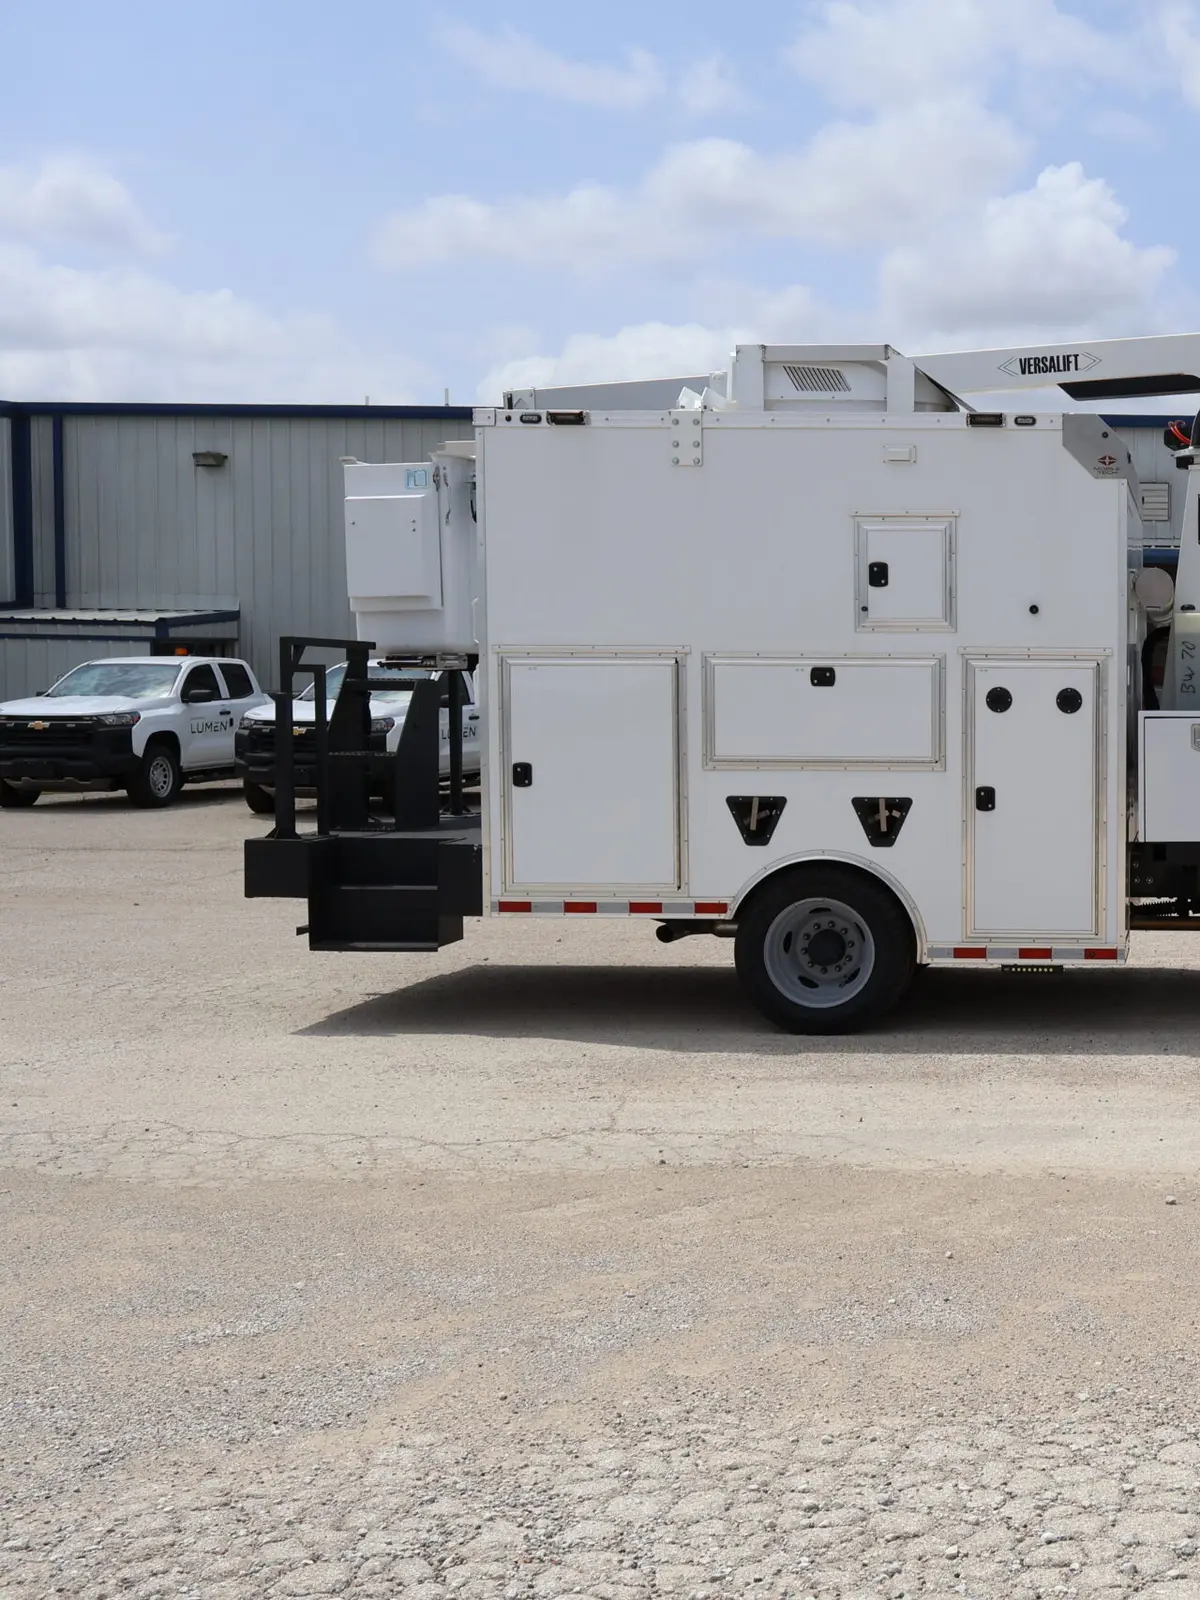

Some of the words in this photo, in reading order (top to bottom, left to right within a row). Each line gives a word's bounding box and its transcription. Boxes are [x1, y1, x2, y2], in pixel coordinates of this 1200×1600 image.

[1019, 354, 1079, 375] VERSALIFT
[1181, 641, 1196, 660] 70
[190, 720, 228, 734] LUMEN
[441, 726, 477, 740] LEN
